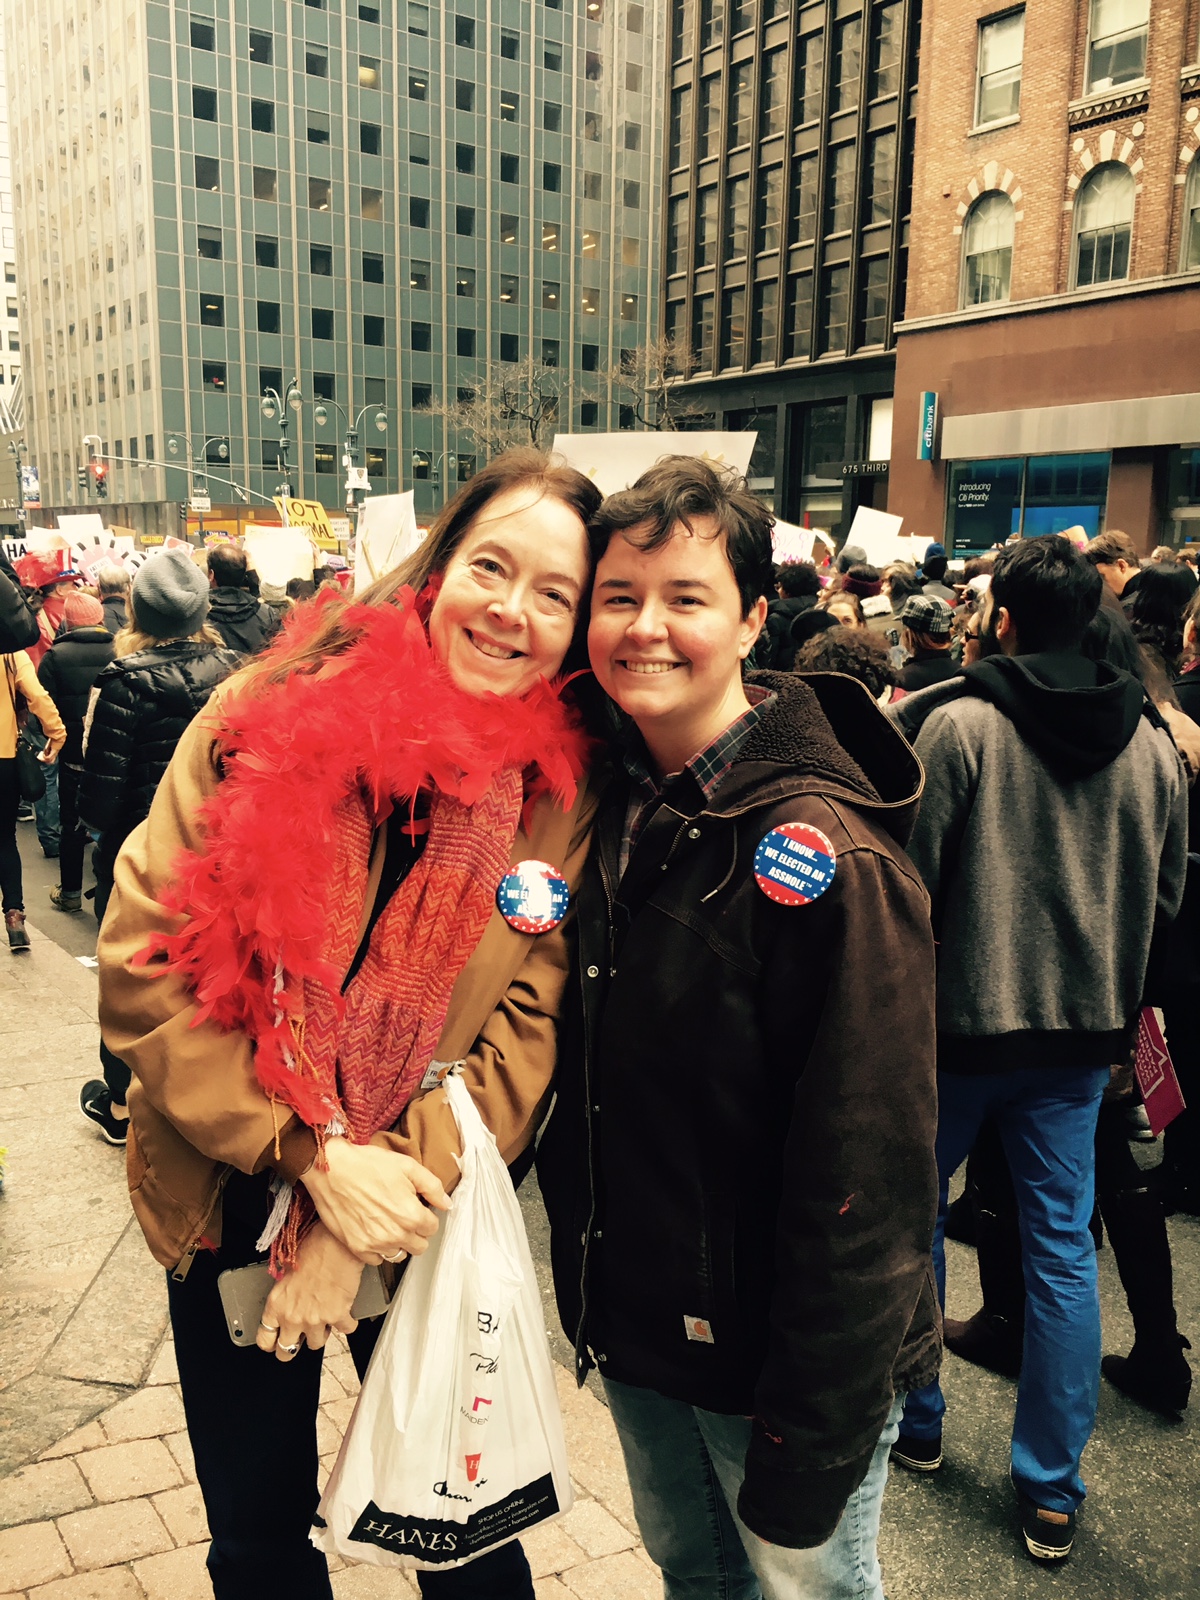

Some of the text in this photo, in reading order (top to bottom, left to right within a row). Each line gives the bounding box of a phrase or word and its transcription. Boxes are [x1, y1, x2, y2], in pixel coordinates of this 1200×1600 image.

[925, 405, 934, 448] citibank
[842, 463, 888, 474] 675 THIRD
[959, 483, 991, 492] Introducing
[783, 837, 789, 847] I
[764, 846, 826, 882] WE ELECTED AN
[507, 889, 520, 899] WE
[552, 893, 563, 903] AN
[478, 1514, 495, 1524] SHOP
[503, 1498, 525, 1513] ONLINE
[363, 1520, 457, 1551] HANES
